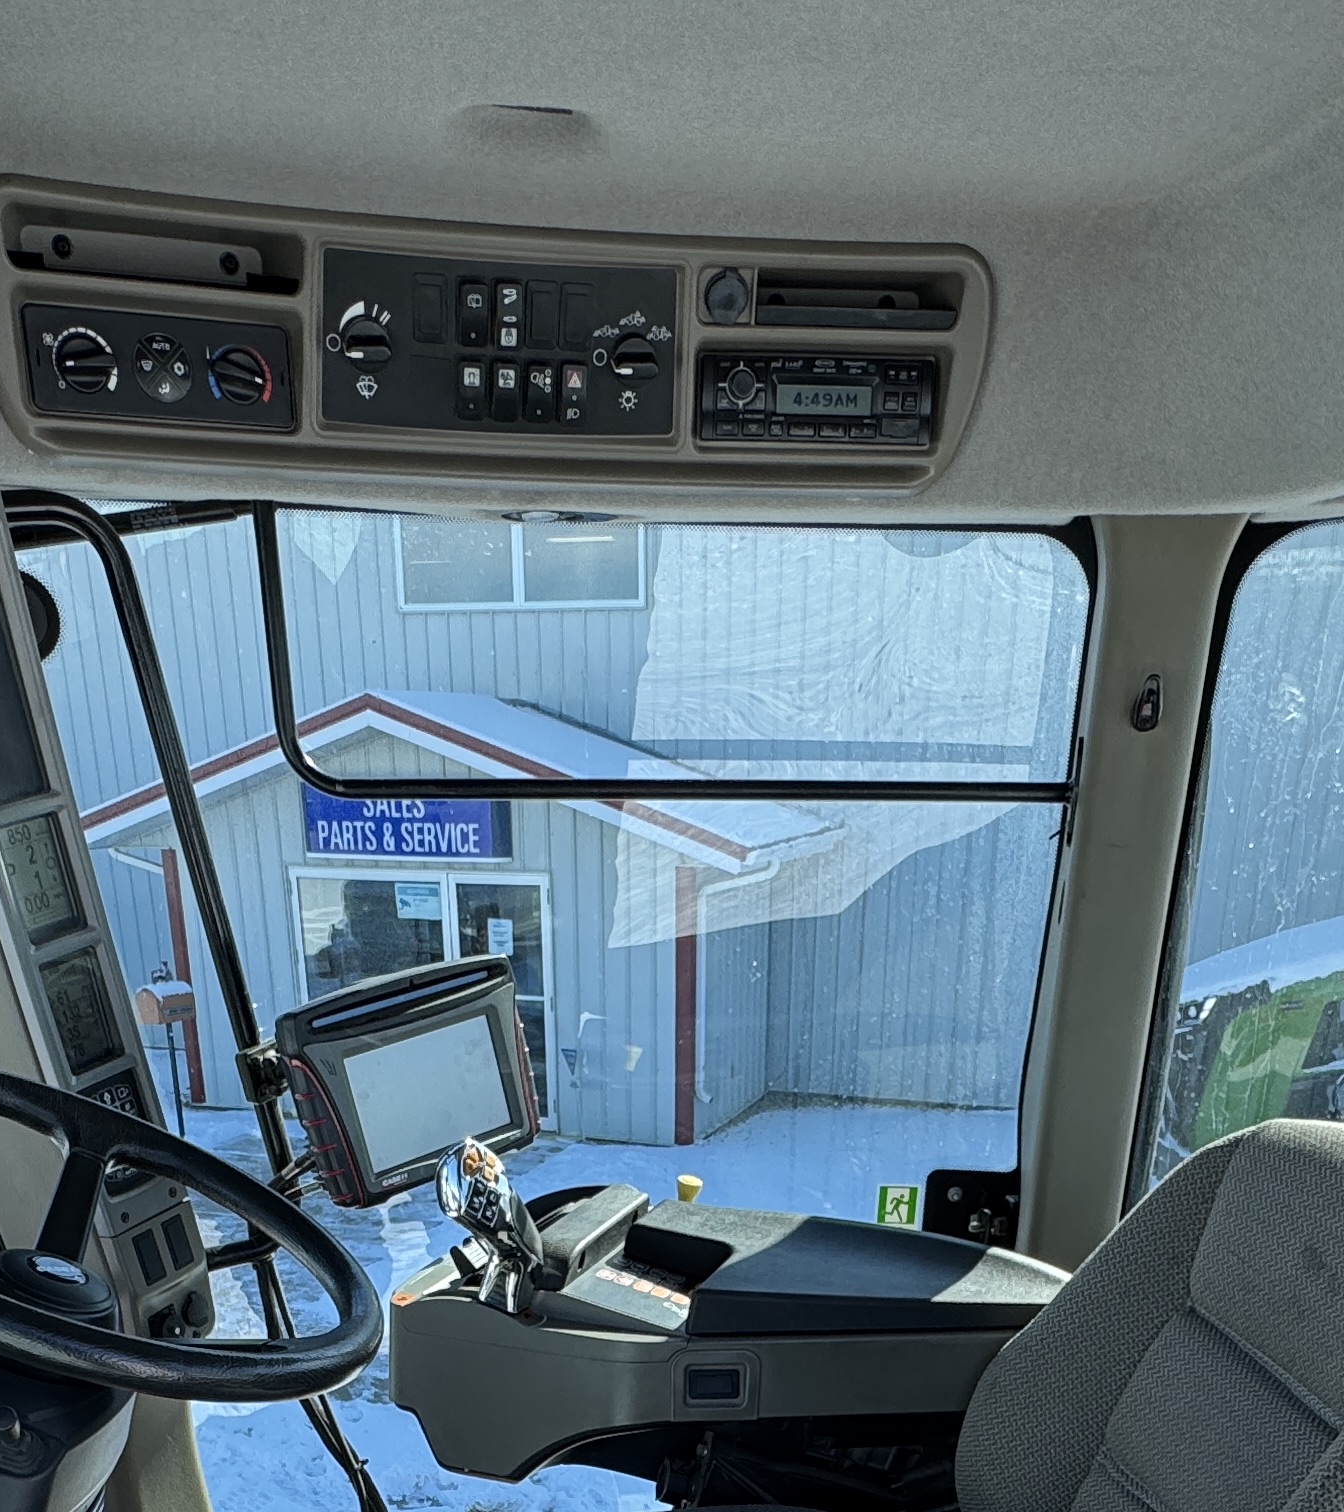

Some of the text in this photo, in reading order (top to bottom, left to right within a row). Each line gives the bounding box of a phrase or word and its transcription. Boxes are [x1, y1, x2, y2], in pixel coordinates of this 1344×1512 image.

[792, 391, 859, 409] 4:49AM
[362, 799, 426, 819] SALES
[7, 824, 32, 846] 850
[317, 820, 480, 853] PARTS & SERVICE
